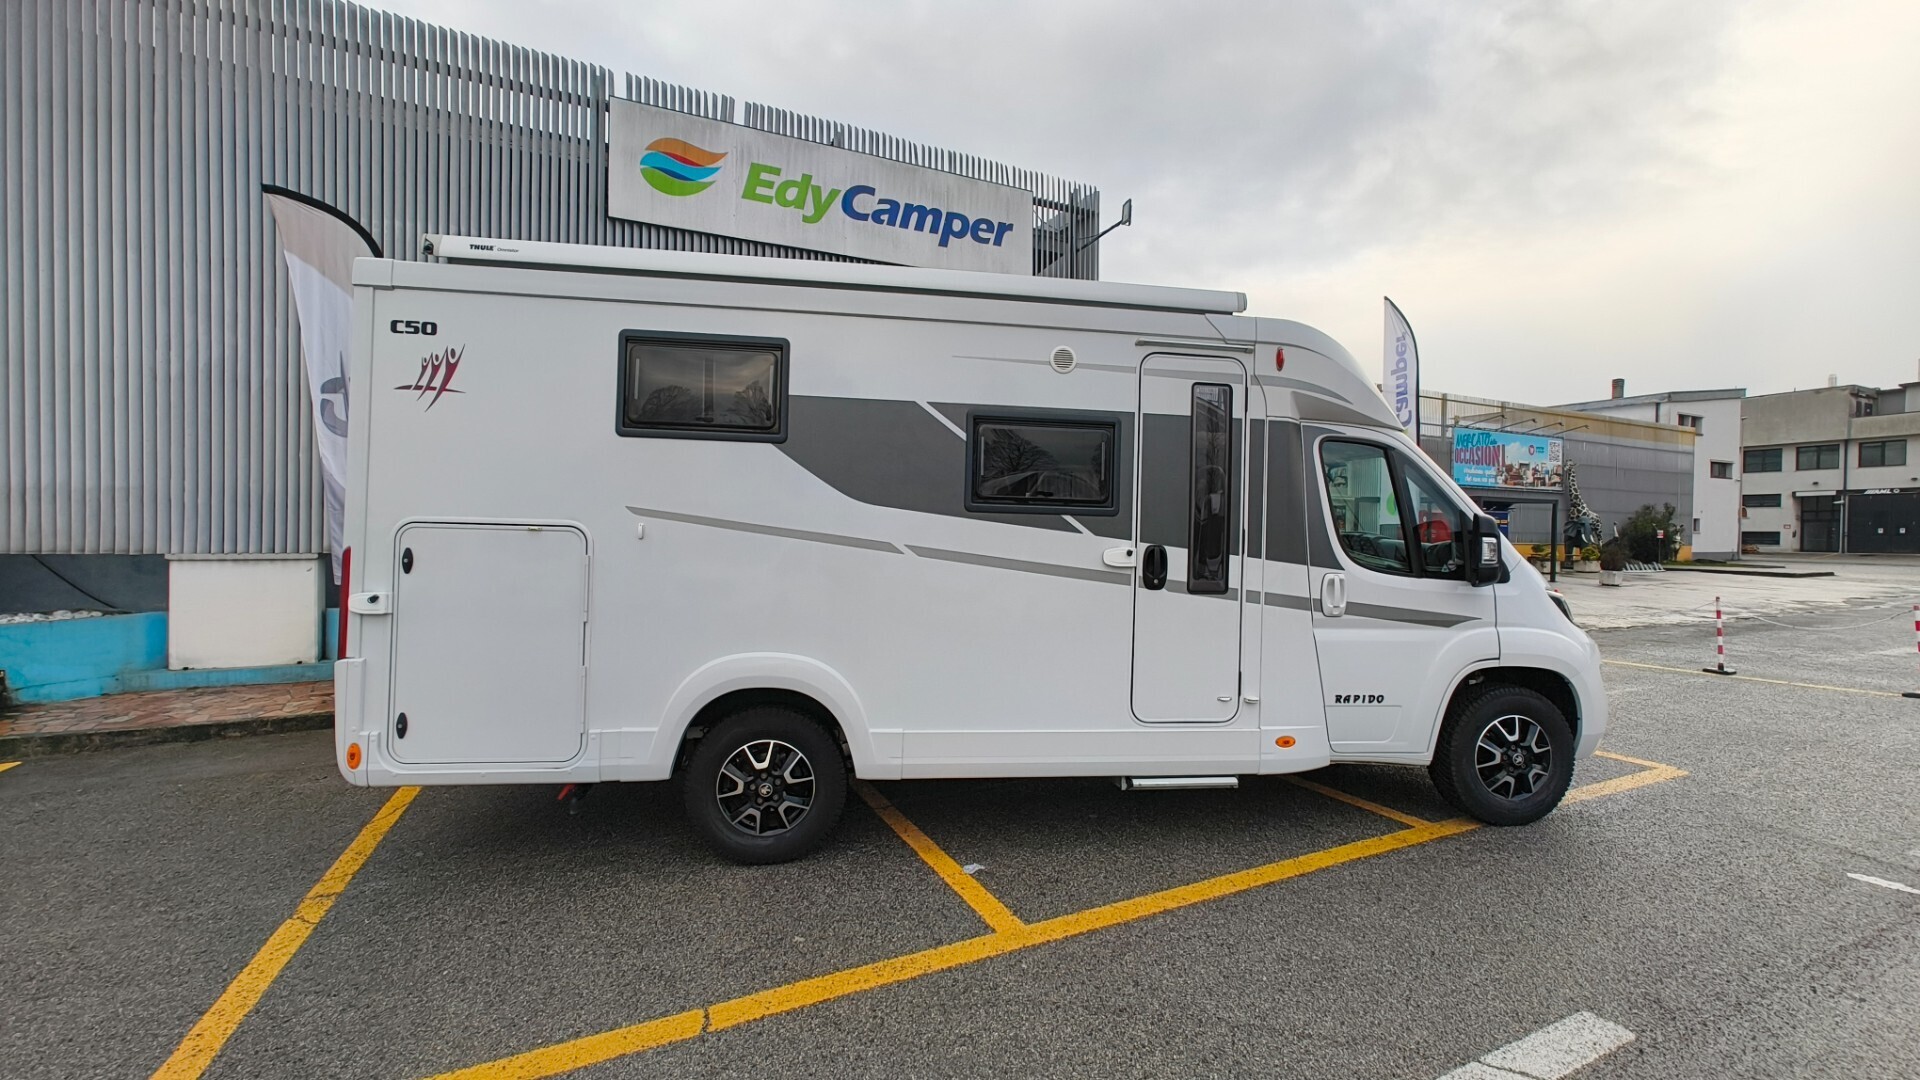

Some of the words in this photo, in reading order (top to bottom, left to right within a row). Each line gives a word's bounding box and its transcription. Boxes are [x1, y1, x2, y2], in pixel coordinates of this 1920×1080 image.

[741, 162, 1014, 247] EdyCamper
[390, 319, 437, 336] C50
[1456, 432, 1491, 448] MERCATO
[1335, 694, 1385, 704] RAPIDO
